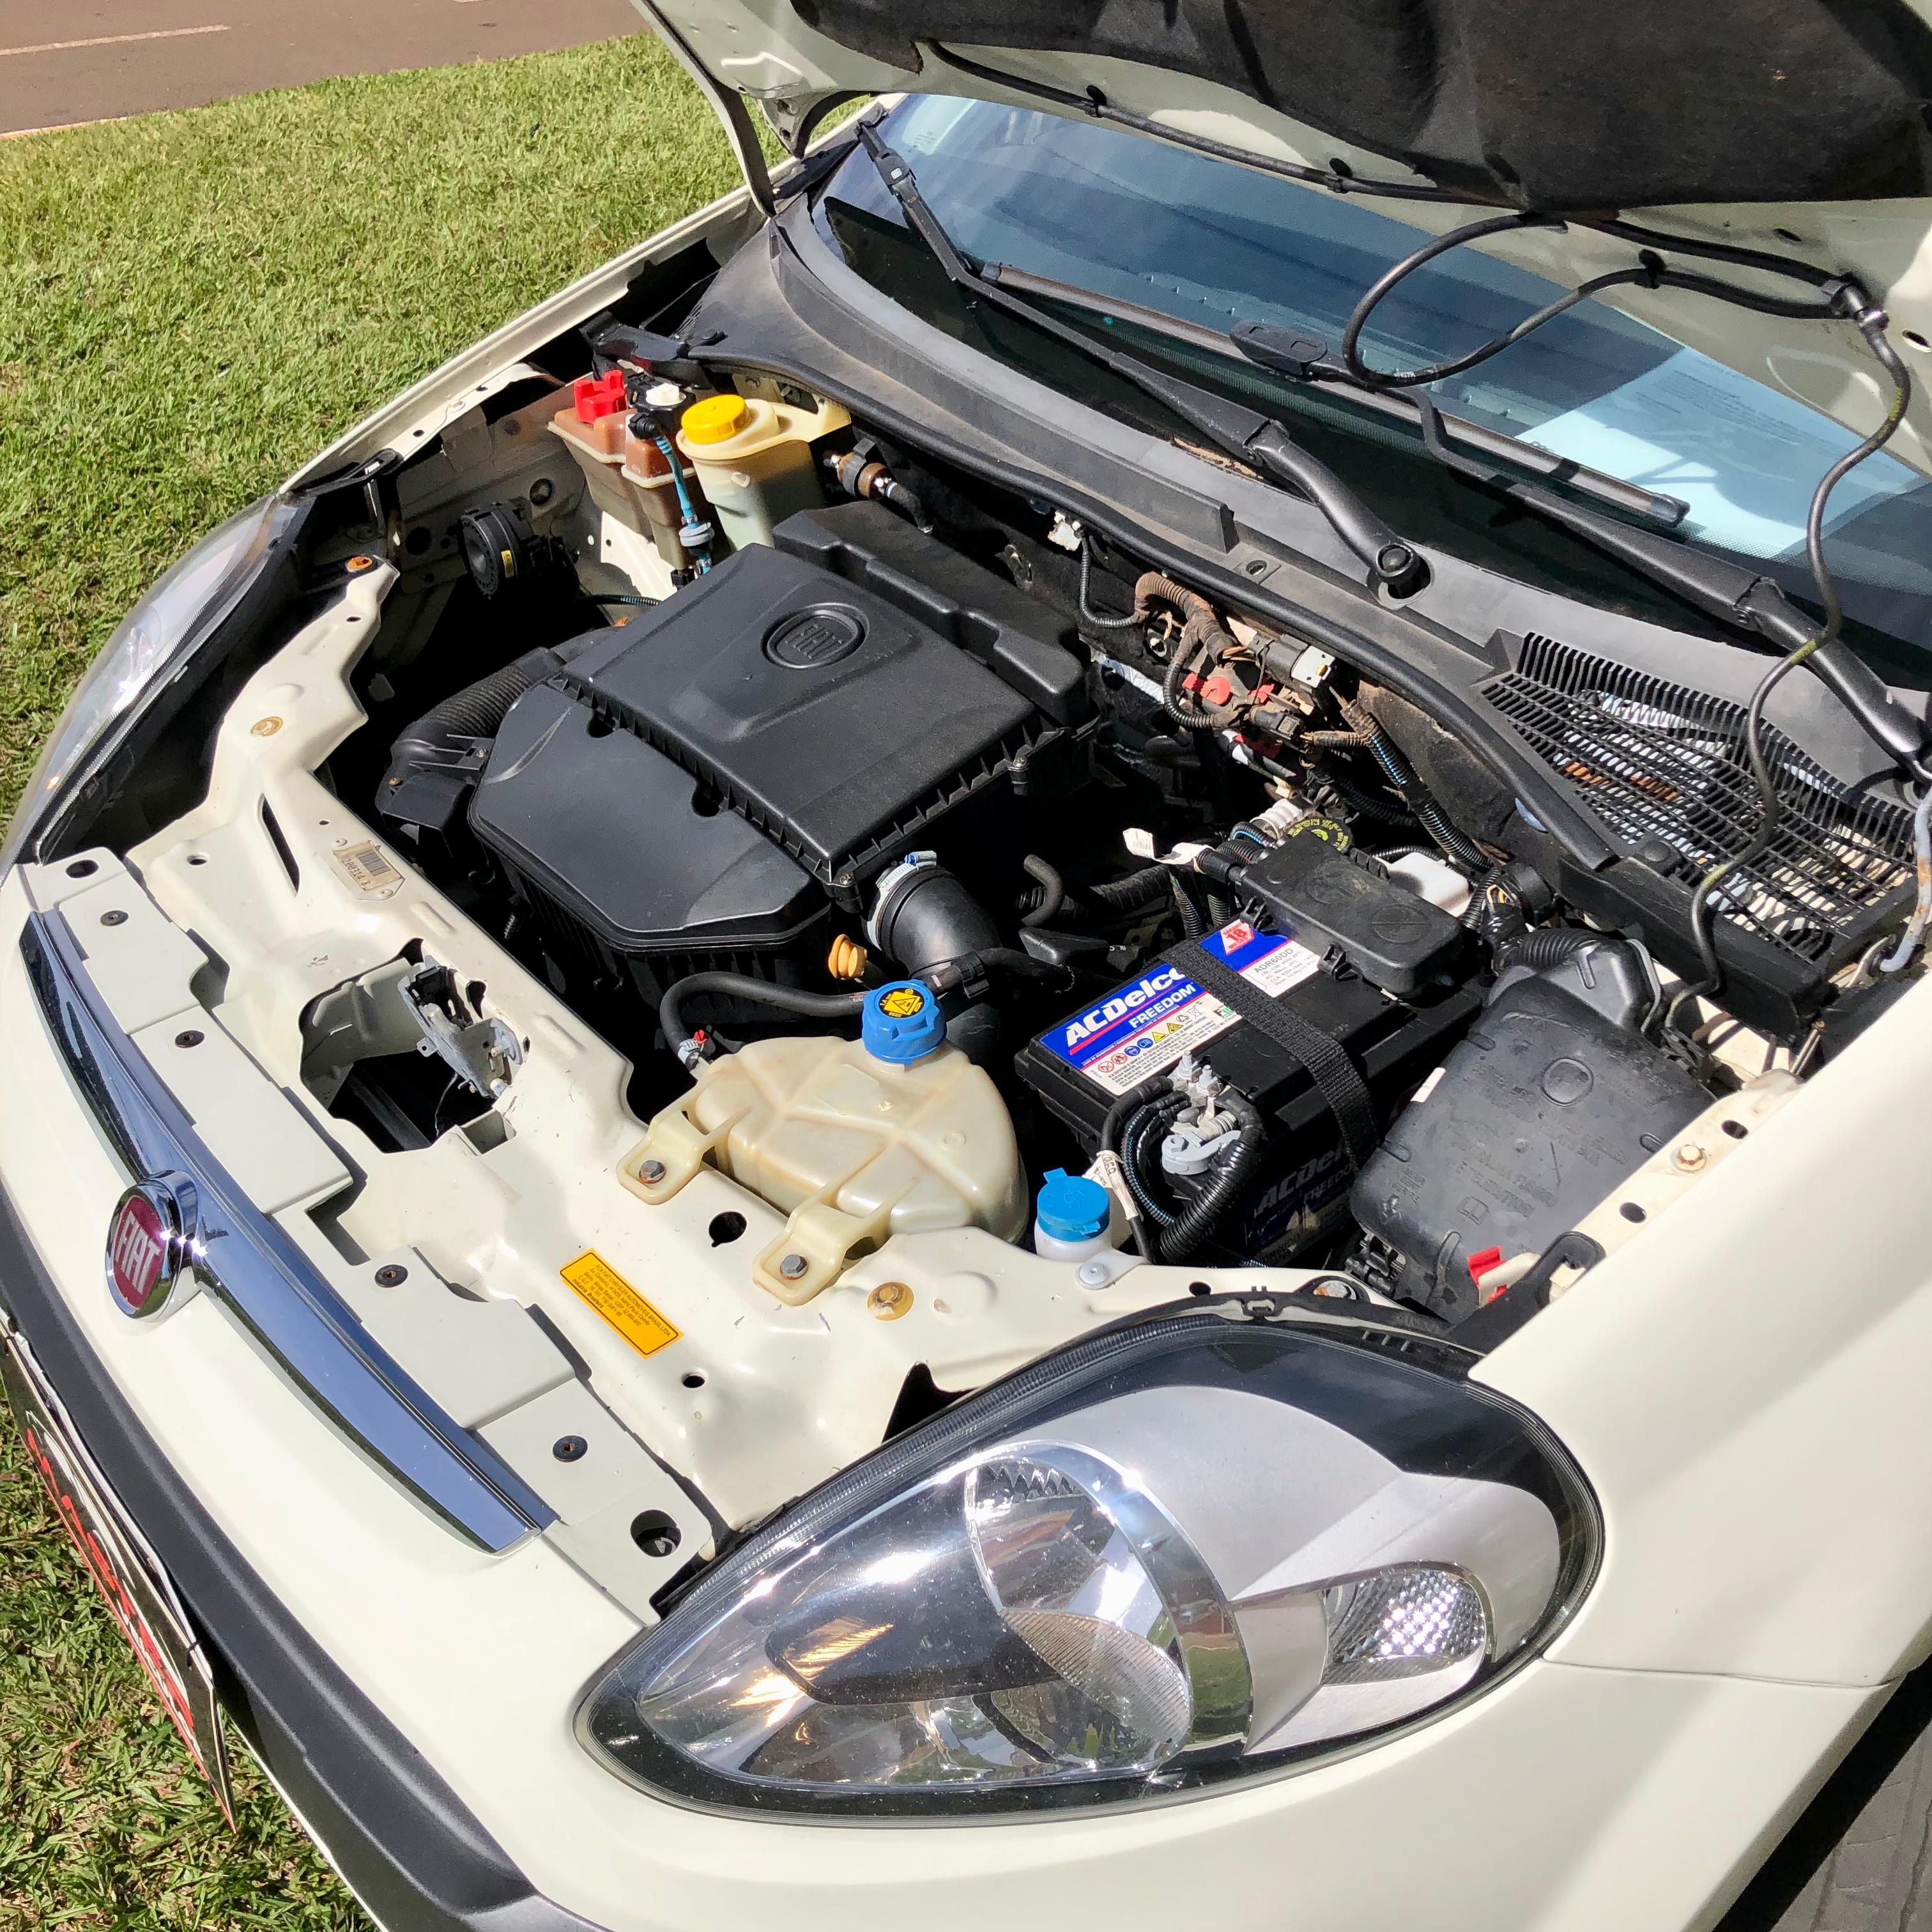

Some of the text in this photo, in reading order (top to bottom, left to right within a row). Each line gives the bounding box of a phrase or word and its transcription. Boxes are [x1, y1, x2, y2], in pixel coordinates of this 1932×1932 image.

[1226, 928, 1248, 942] 18
[1254, 948, 1294, 973] ADR60DD
[1128, 983, 1197, 1029] FREEDOM
[115, 1209, 161, 1296] FIAT
